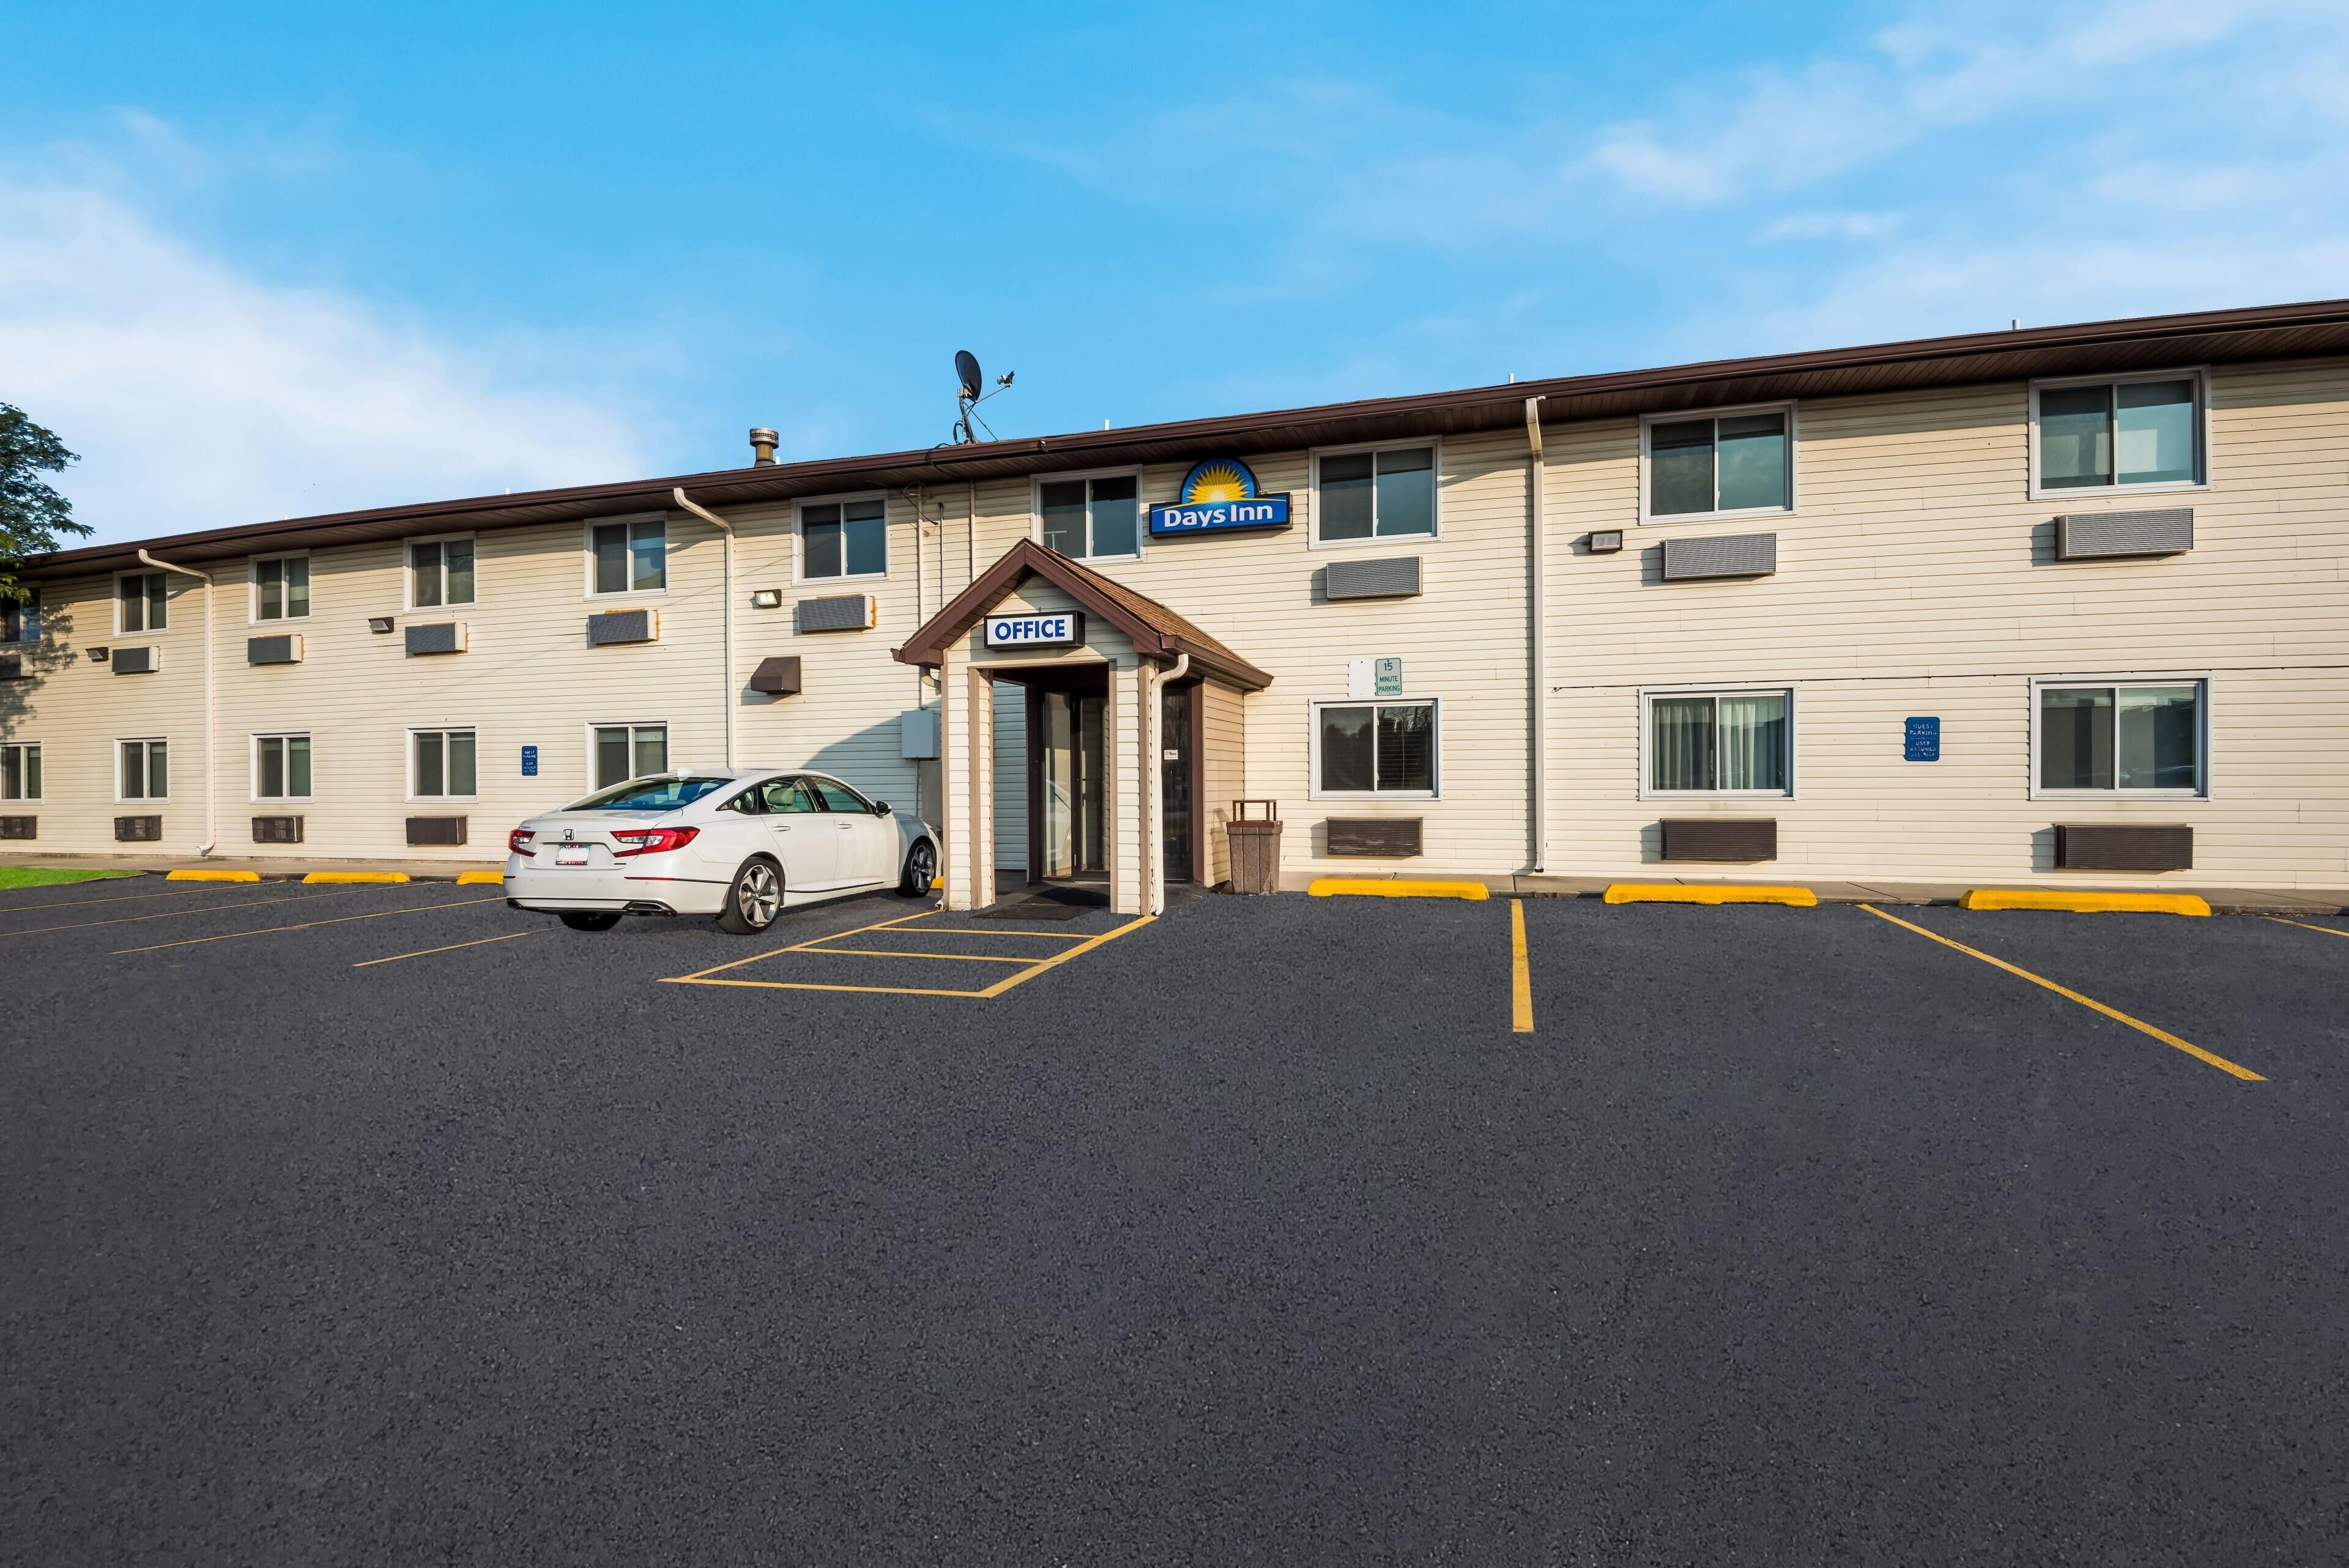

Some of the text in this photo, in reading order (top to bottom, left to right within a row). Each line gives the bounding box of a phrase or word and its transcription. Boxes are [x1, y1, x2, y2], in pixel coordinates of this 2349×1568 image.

[1164, 505, 1272, 527] Days Inn
[995, 619, 1065, 640] OFFICE
[1384, 662, 1393, 671] 15
